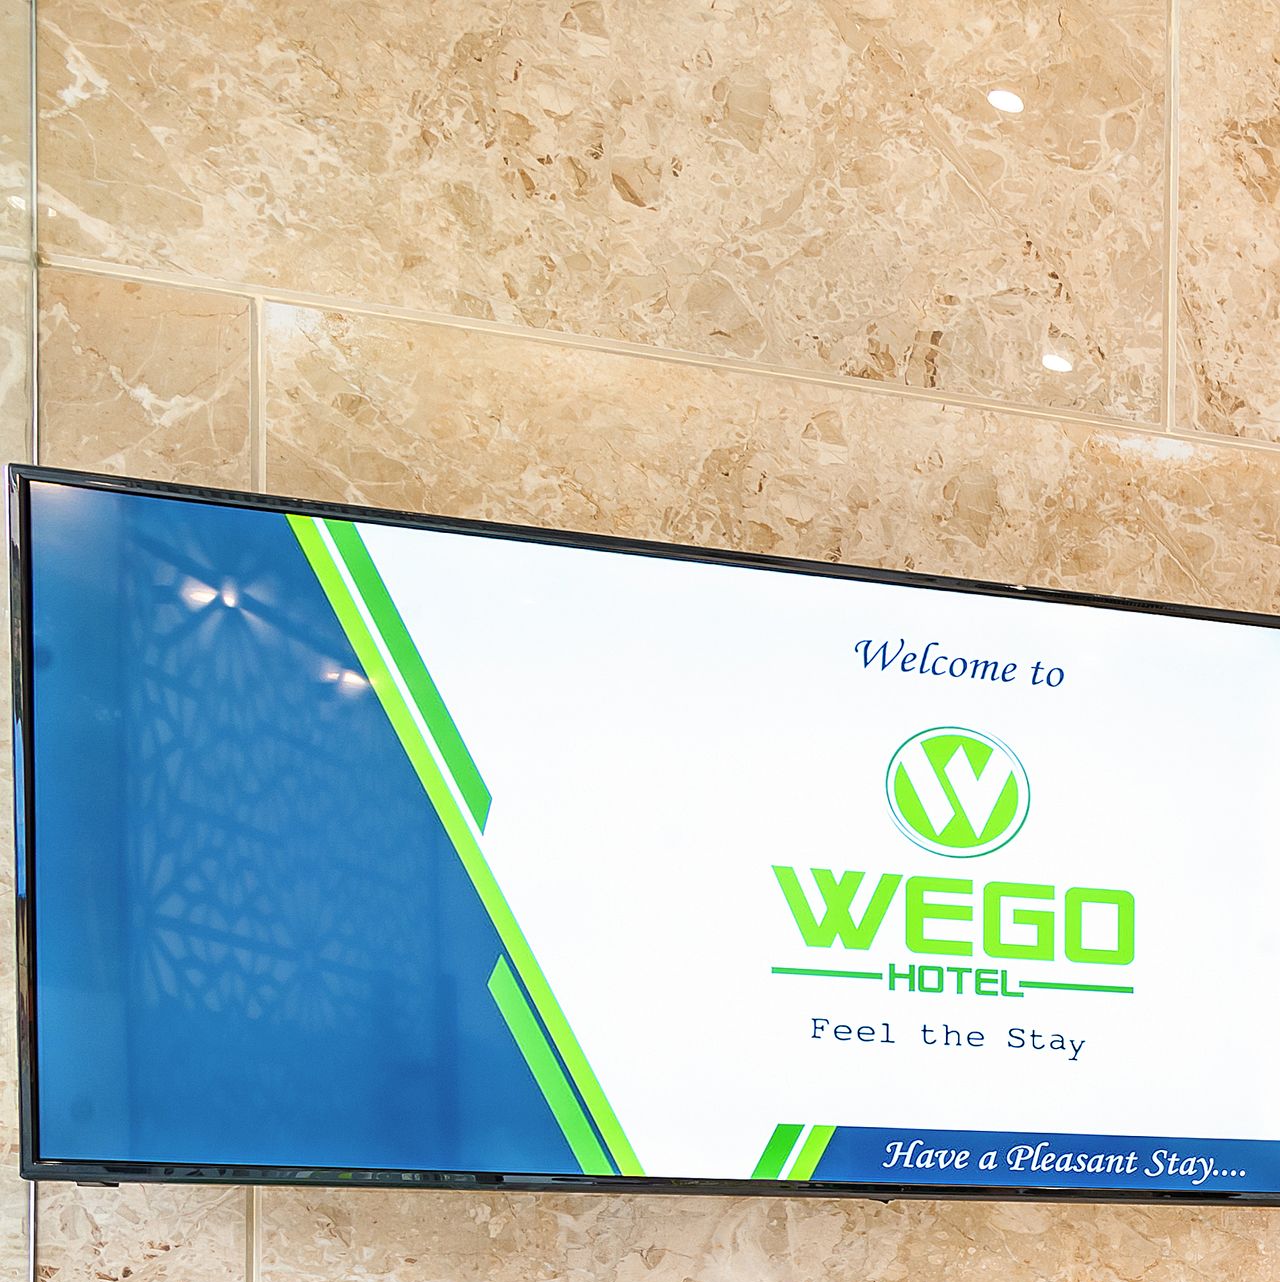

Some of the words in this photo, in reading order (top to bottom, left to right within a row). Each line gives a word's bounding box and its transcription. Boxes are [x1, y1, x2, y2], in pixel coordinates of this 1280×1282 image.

[854, 638, 1018, 683] Welcome
[1030, 661, 1065, 688] to
[771, 865, 1135, 966] WEGO
[888, 963, 1025, 998] HOTEL
[811, 1017, 896, 1044] Feel
[920, 1023, 985, 1047] the
[1007, 1027, 1086, 1061] Stay
[882, 1139, 970, 1171] Have
[978, 1149, 999, 1171] a
[1005, 1141, 1139, 1176] Pleasant
[1143, 1149, 1246, 1186] Stay....
